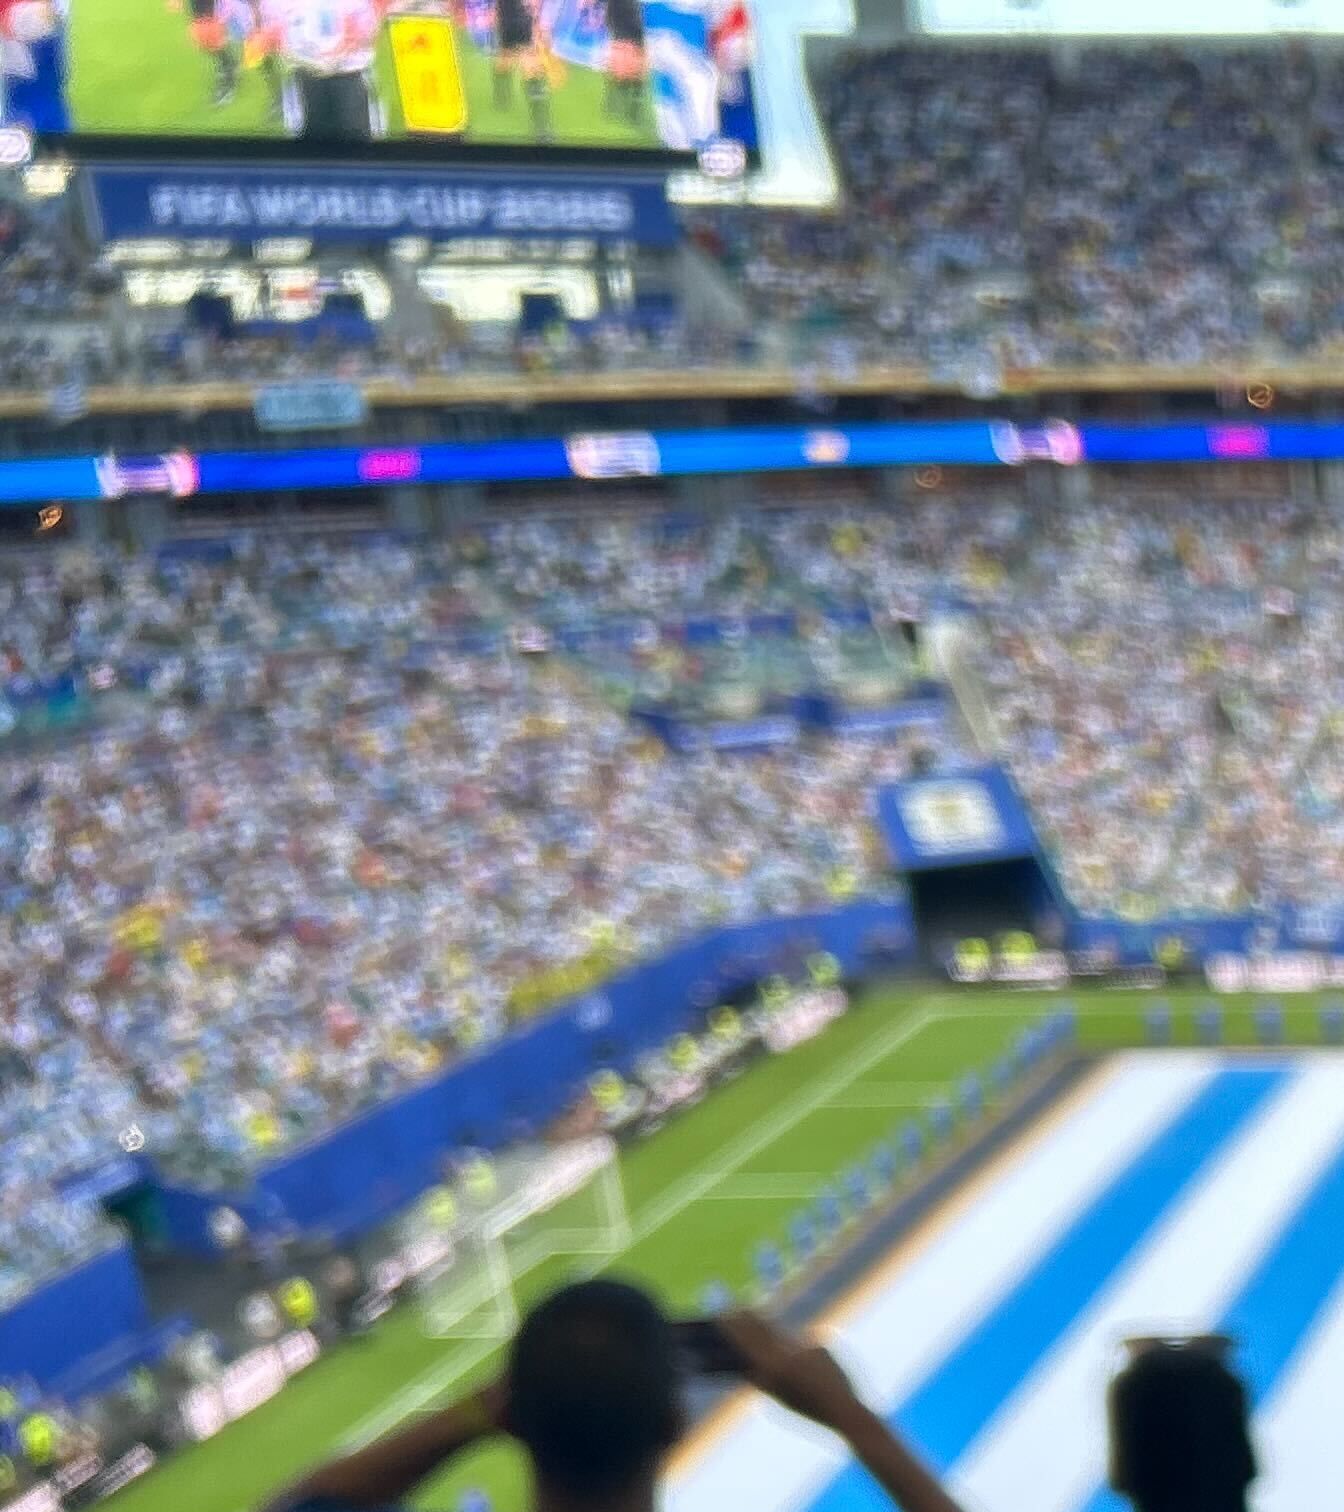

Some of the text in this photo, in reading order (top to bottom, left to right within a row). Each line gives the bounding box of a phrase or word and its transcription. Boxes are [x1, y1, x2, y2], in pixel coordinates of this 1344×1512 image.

[149, 185, 251, 227] FIFA
[254, 186, 403, 229] WORLD
[406, 187, 487, 229] CUP
